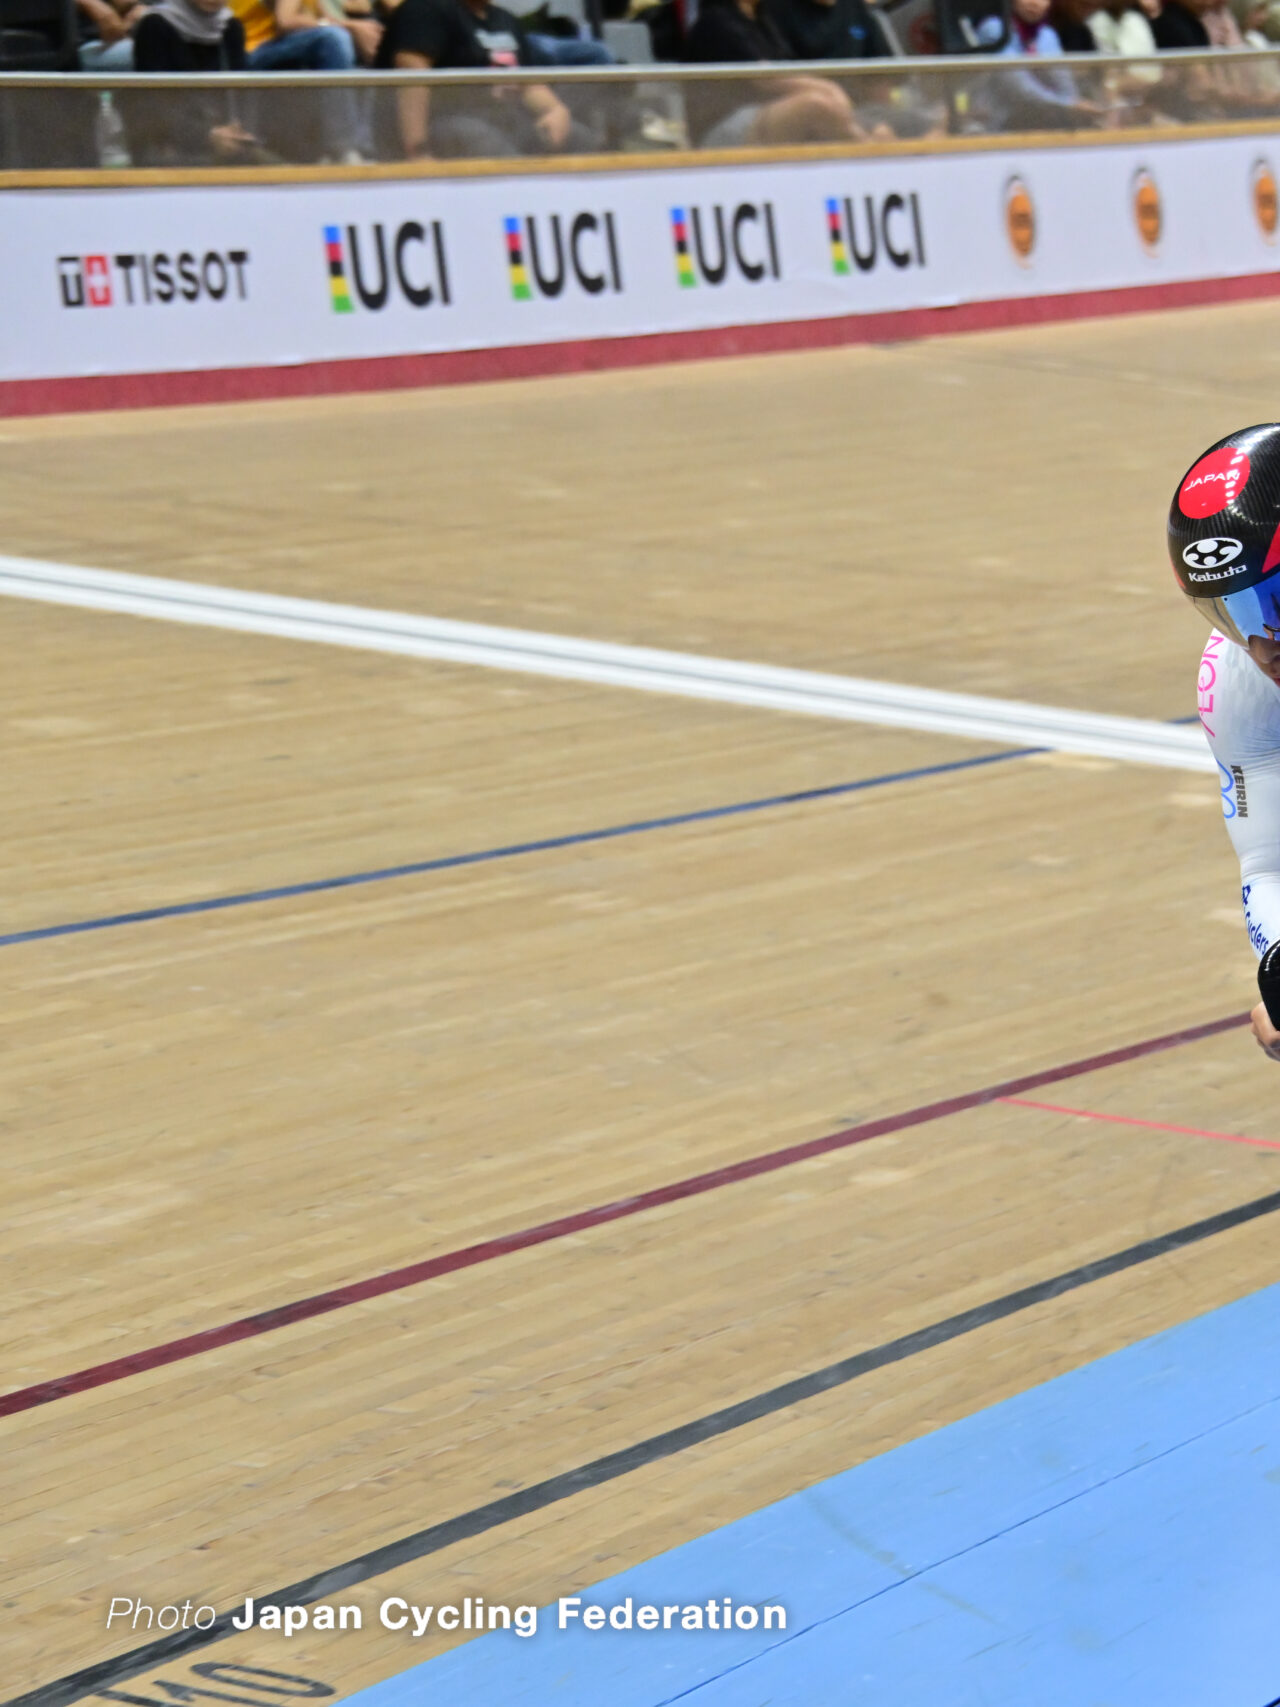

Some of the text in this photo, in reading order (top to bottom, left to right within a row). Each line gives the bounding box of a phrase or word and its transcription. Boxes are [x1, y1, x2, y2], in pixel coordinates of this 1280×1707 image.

[347, 220, 451, 311] UCI
[525, 211, 623, 298] UCI
[691, 202, 781, 286] UCI
[844, 193, 926, 272] UCI
[115, 251, 249, 304] TISSOT
[1188, 563, 1248, 582] Kabuto
[1230, 765, 1249, 818] KEIRIN
[1246, 911, 1270, 955] yclers
